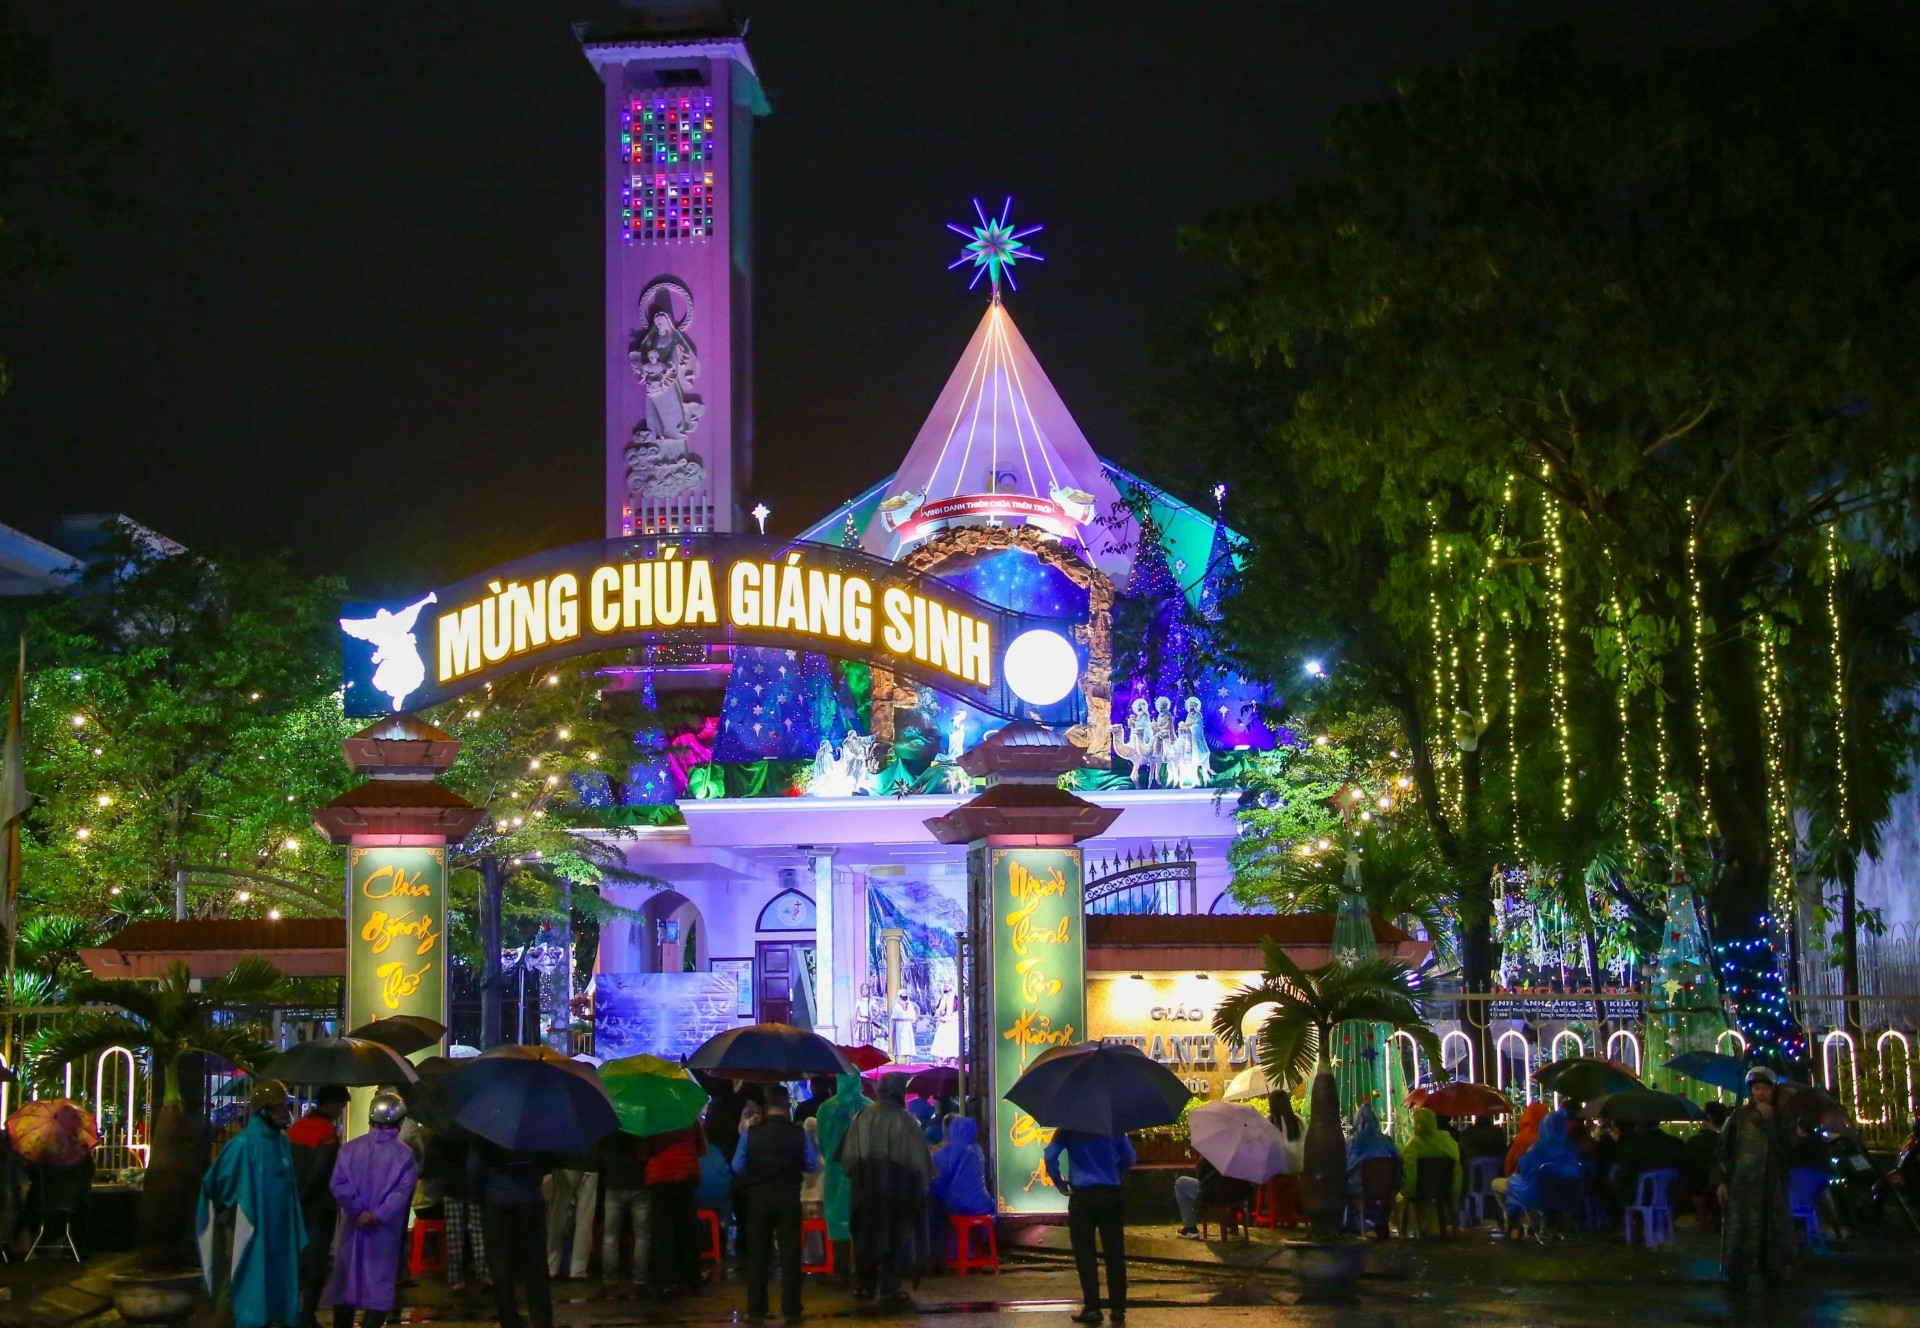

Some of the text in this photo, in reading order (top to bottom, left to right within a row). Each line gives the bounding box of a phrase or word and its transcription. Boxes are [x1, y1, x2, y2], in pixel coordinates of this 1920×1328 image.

[944, 503, 966, 513] DANH
[439, 546, 992, 685] MỪNG CHÚA GIÁNG SINH
[361, 910, 442, 956] Giáng
[1150, 1002, 1204, 1022] GIÁO
